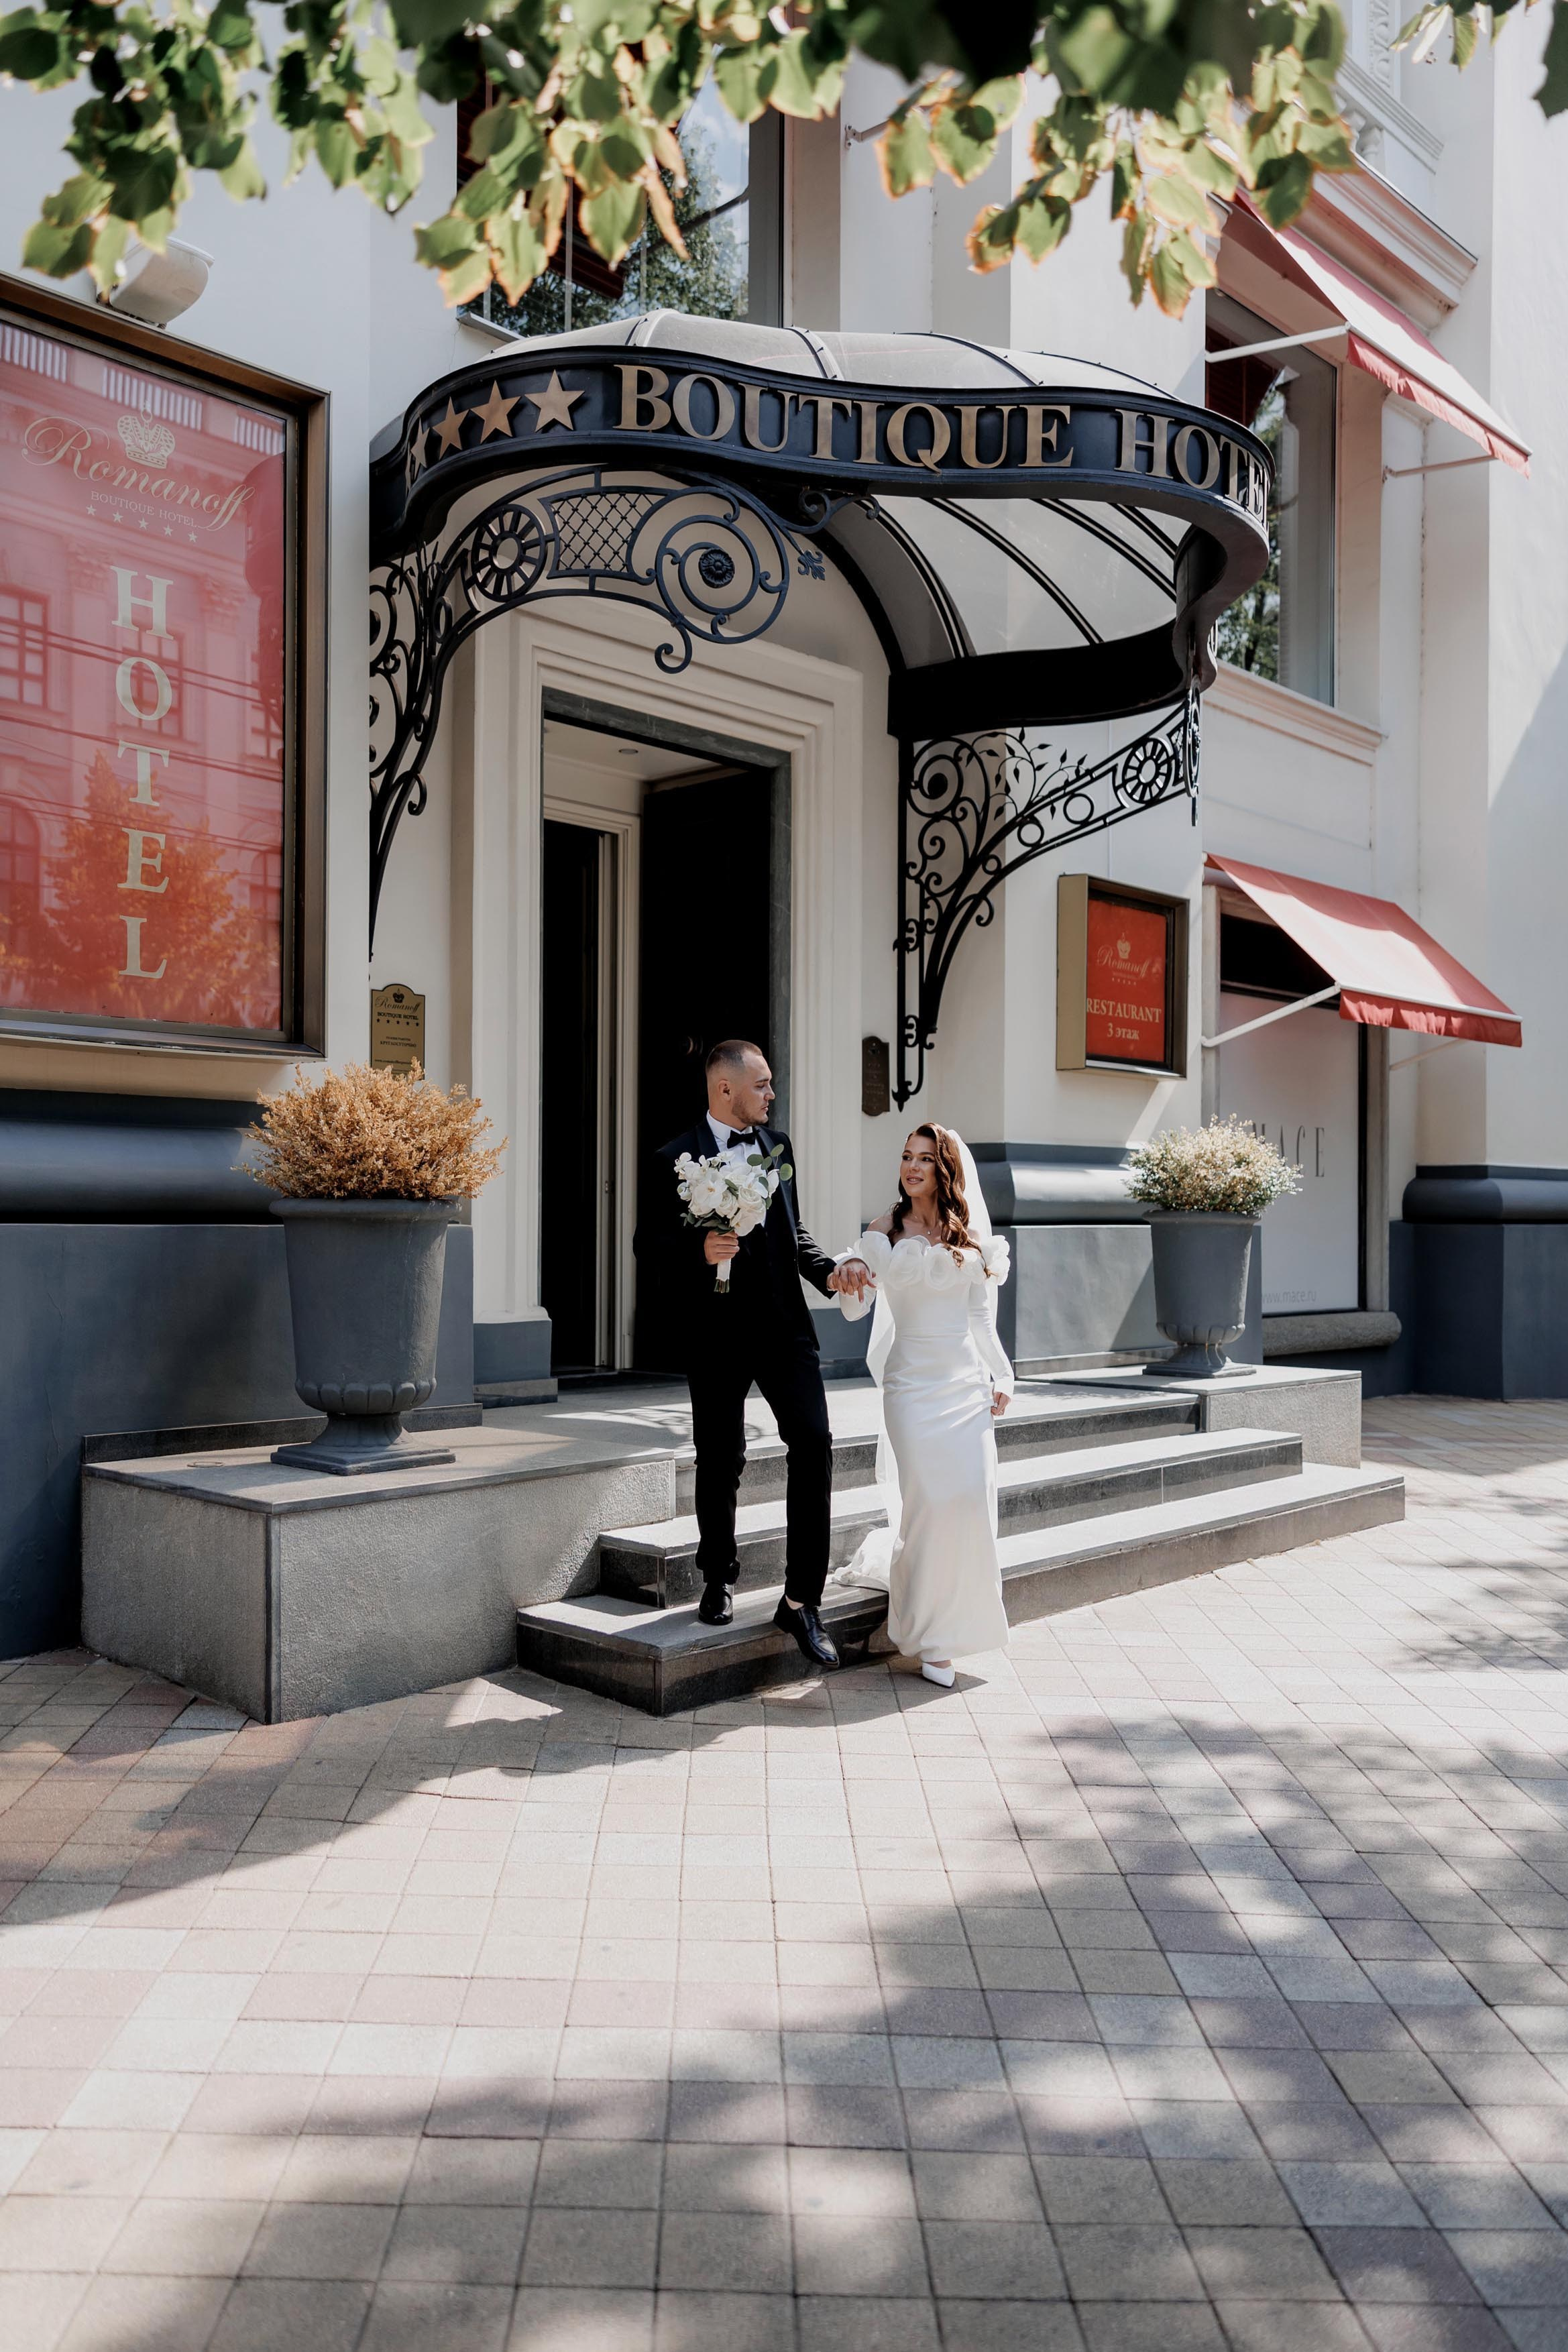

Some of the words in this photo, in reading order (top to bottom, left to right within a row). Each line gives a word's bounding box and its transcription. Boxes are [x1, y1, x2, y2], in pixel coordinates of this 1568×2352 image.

[612, 364, 1074, 475] BOUTIQUE
[1114, 407, 1270, 537] HOTEL
[21, 416, 256, 531] Romanoff
[91, 490, 154, 516] BOUTIQUE
[159, 509, 197, 528] HOTEL
[110, 565, 174, 979] HOTEL
[1097, 944, 1150, 977] Romanoff
[376, 995, 421, 1013] Romanoff
[378, 1011, 402, 1019] BOUTIQUE
[1086, 997, 1162, 1023] RESTAURANT
[1107, 1023, 1113, 1038] 3
[1115, 1027, 1139, 1040] этаж
